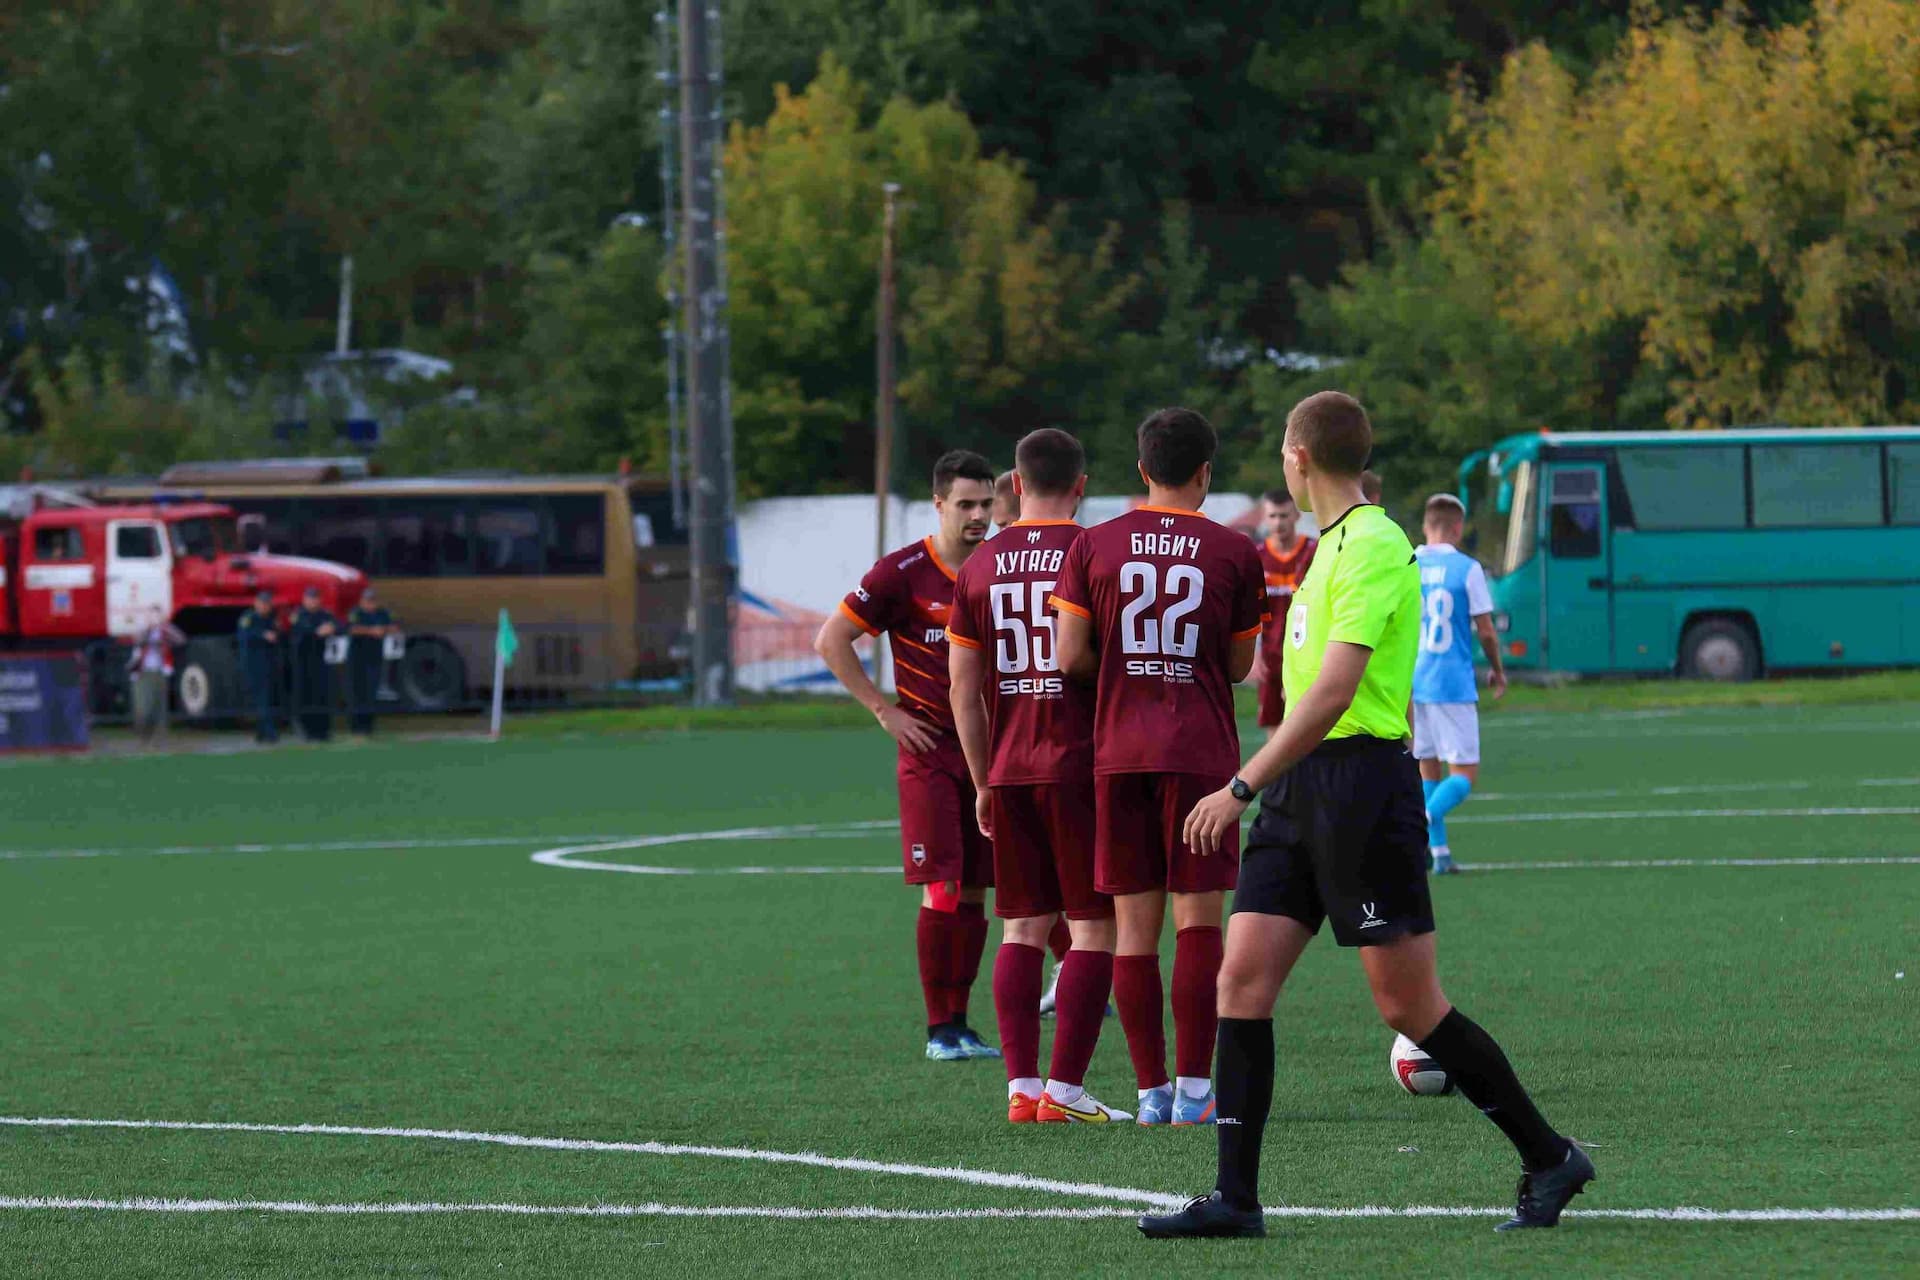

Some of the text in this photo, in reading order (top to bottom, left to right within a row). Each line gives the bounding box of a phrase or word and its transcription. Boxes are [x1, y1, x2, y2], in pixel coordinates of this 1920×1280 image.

[1130, 532, 1201, 560] БАБИЧ
[994, 549, 1065, 577] ХУГАЕВ
[1119, 561, 1205, 658] 22
[989, 580, 1060, 674] 55
[1125, 660, 1194, 678] SEUS
[999, 677, 1063, 695] SEUS
